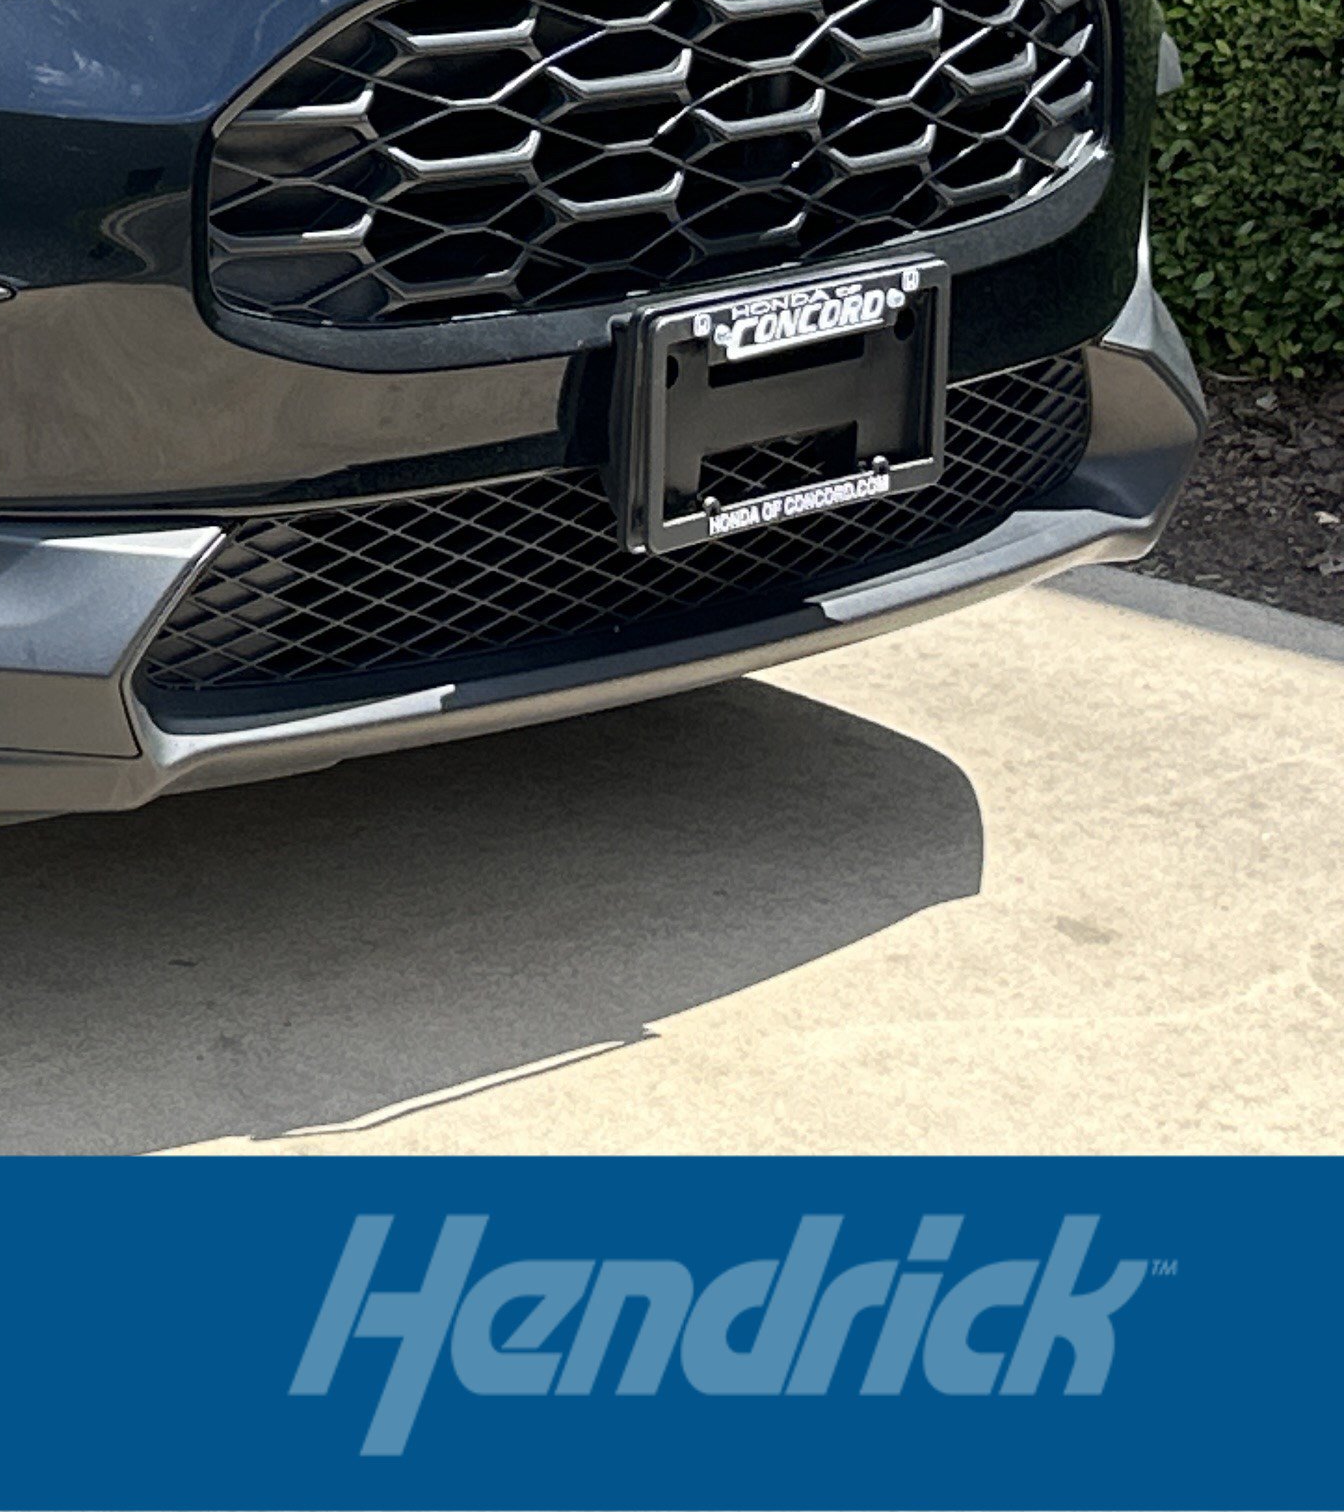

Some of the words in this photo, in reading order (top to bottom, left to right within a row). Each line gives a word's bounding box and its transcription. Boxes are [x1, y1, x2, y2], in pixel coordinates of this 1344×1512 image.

[726, 289, 886, 359] CONCORD
[732, 288, 829, 320] HONDA
[709, 505, 760, 536] HONDA
[762, 500, 783, 521] OF
[783, 474, 890, 516] CONCORD.COM
